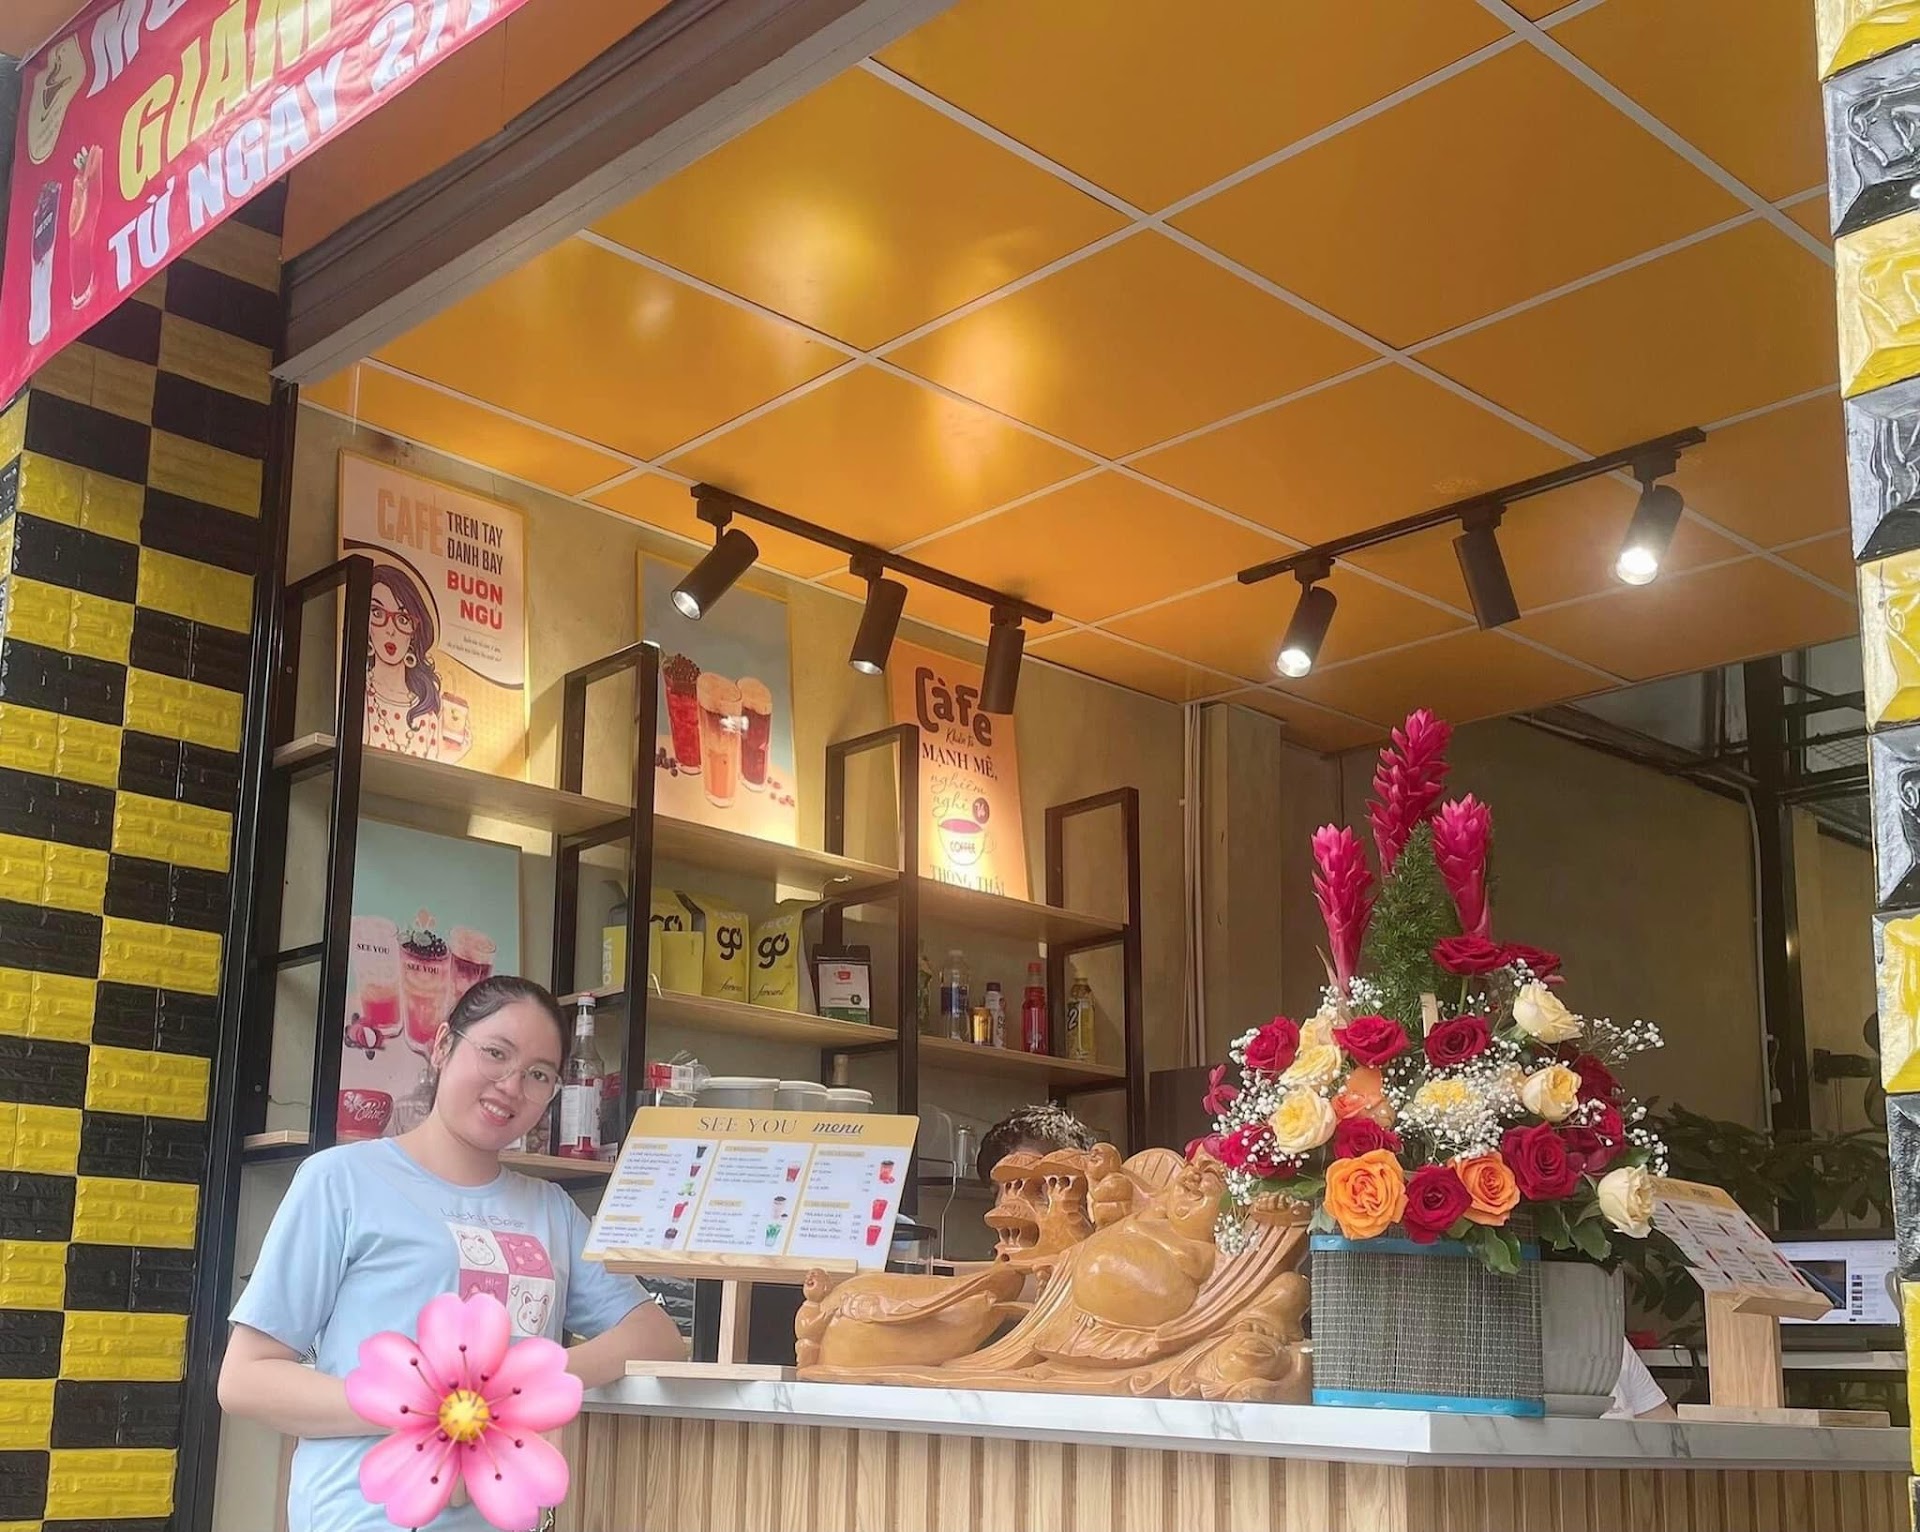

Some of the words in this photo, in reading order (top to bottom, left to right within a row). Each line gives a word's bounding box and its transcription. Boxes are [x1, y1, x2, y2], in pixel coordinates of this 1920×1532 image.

[697, 1116, 738, 1133] SEE
[748, 1117, 800, 1135] YOU
[811, 1121, 865, 1135] menu
